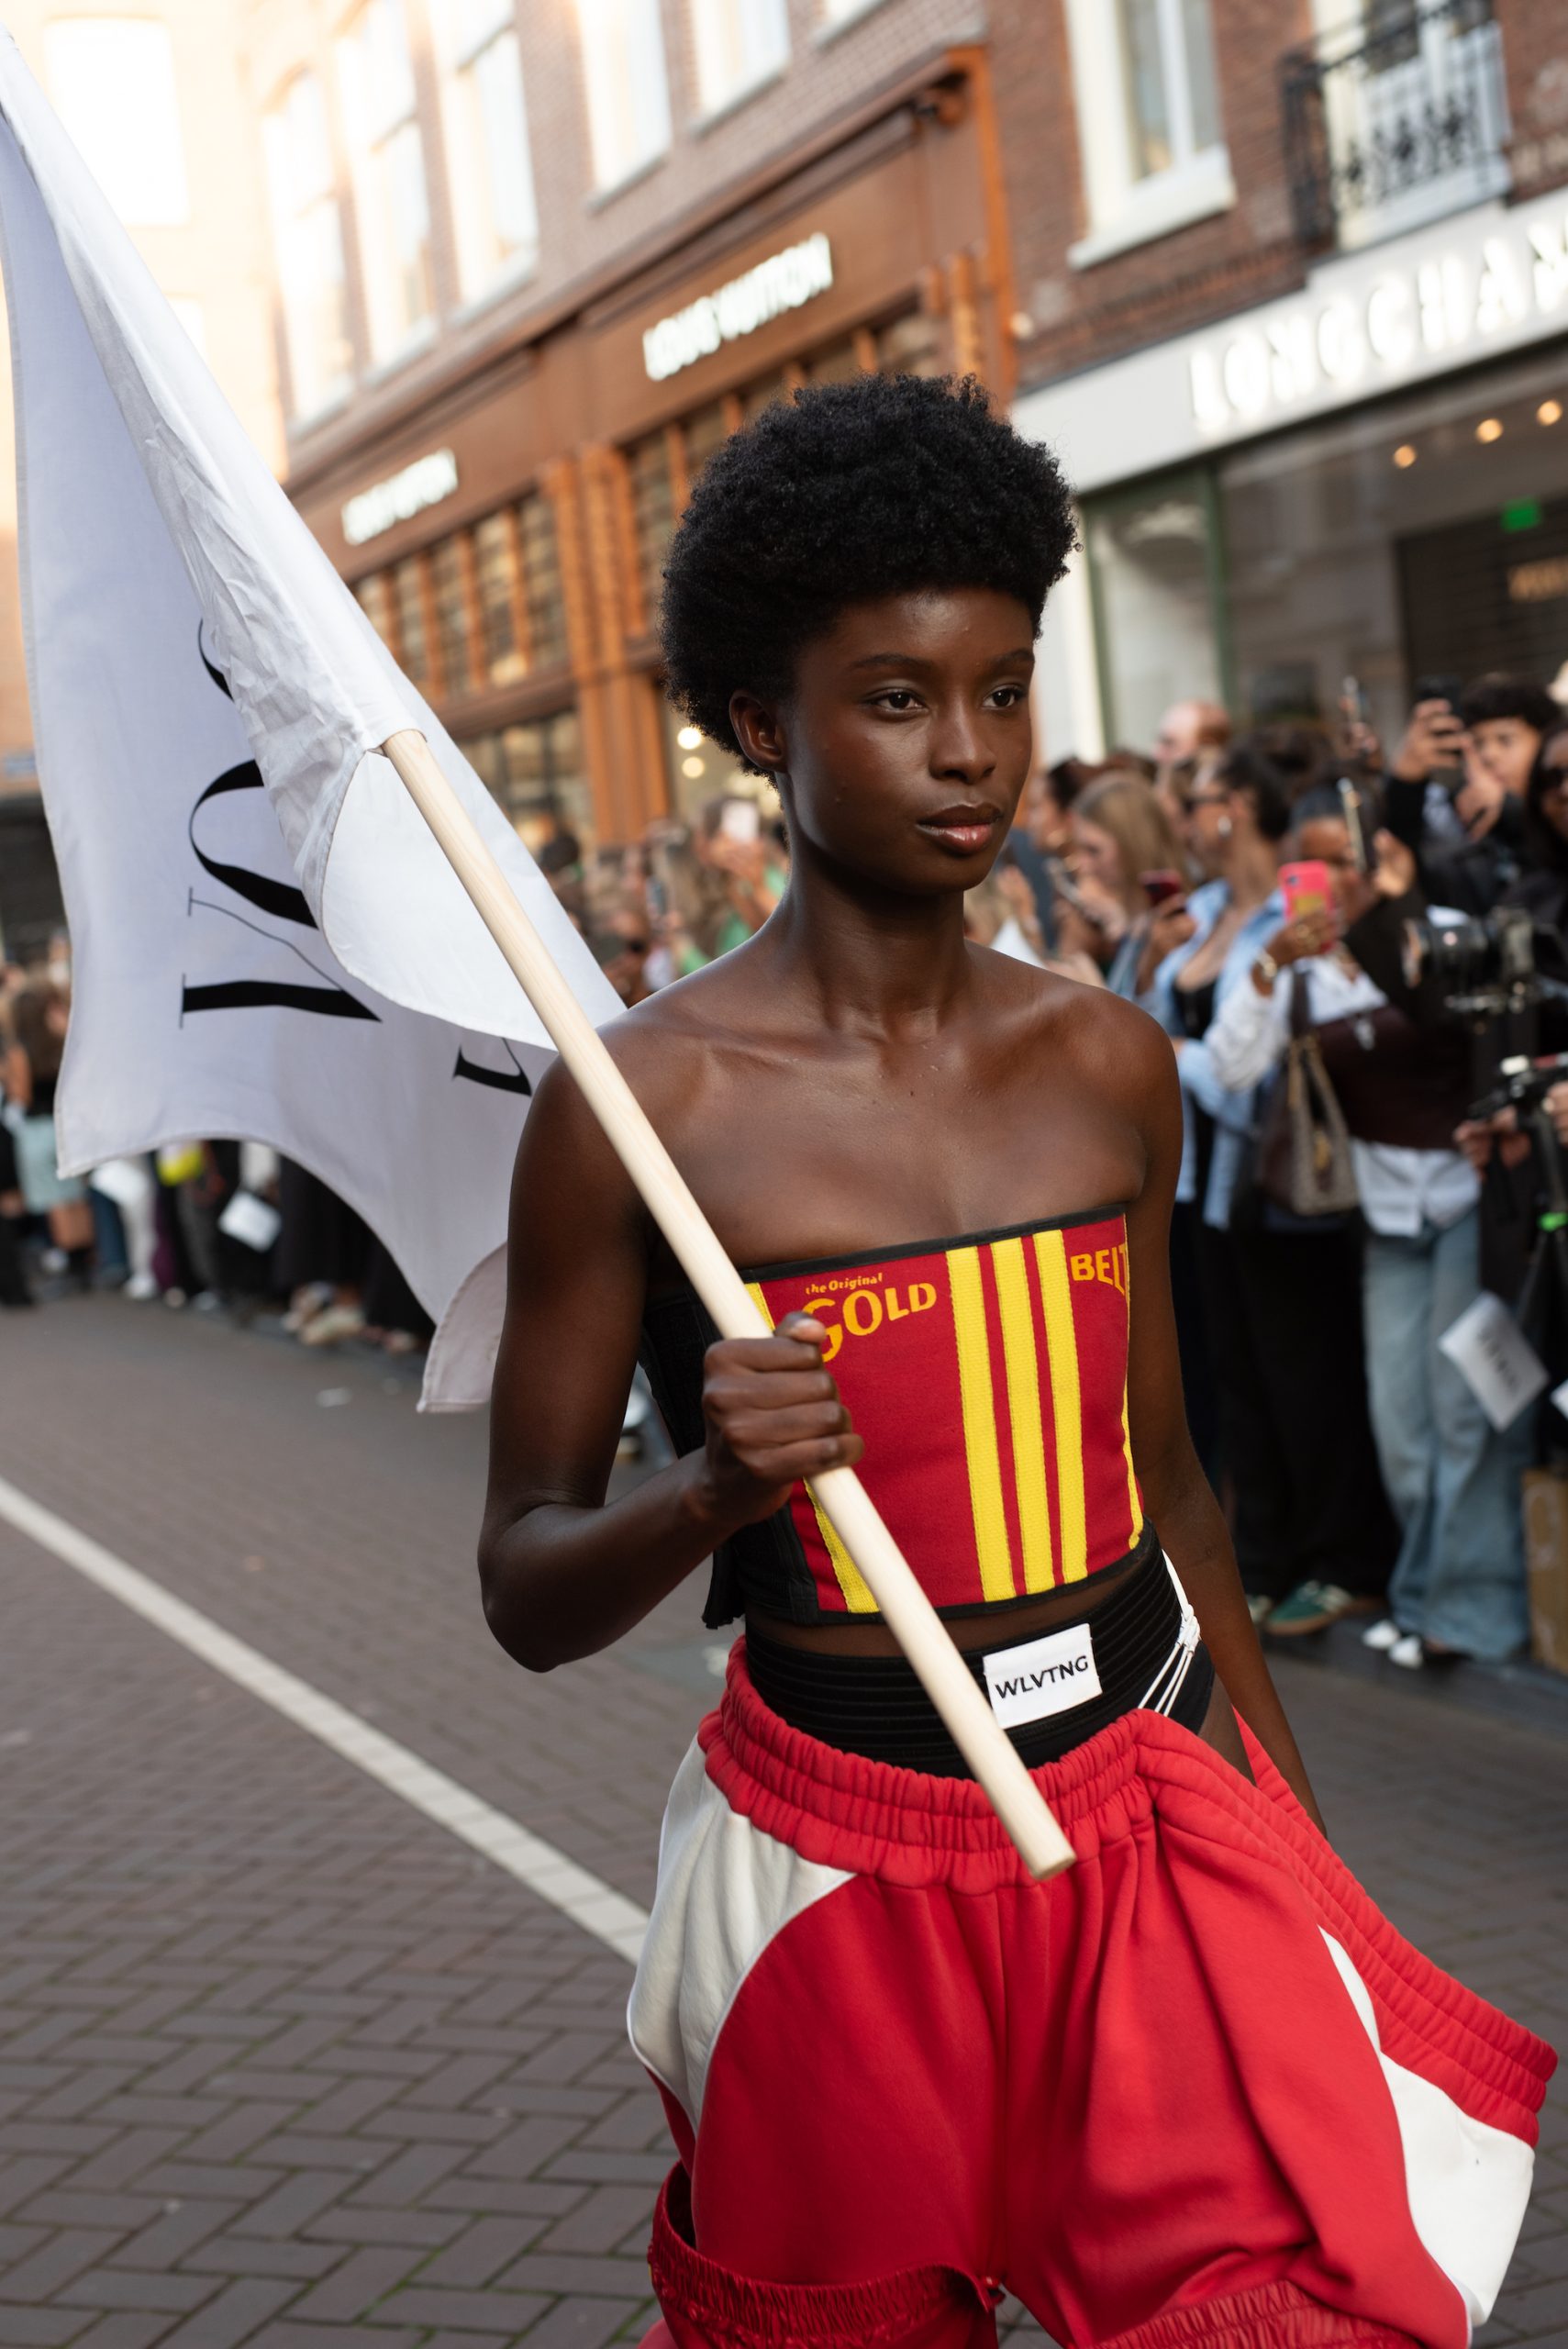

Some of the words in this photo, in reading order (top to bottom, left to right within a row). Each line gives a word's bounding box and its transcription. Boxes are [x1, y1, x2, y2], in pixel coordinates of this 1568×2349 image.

[806, 1284, 827, 1295] the
[828, 1273, 883, 1290] Original
[802, 1283, 937, 1363] GOLD
[995, 1655, 1088, 1698] WLVTNG
